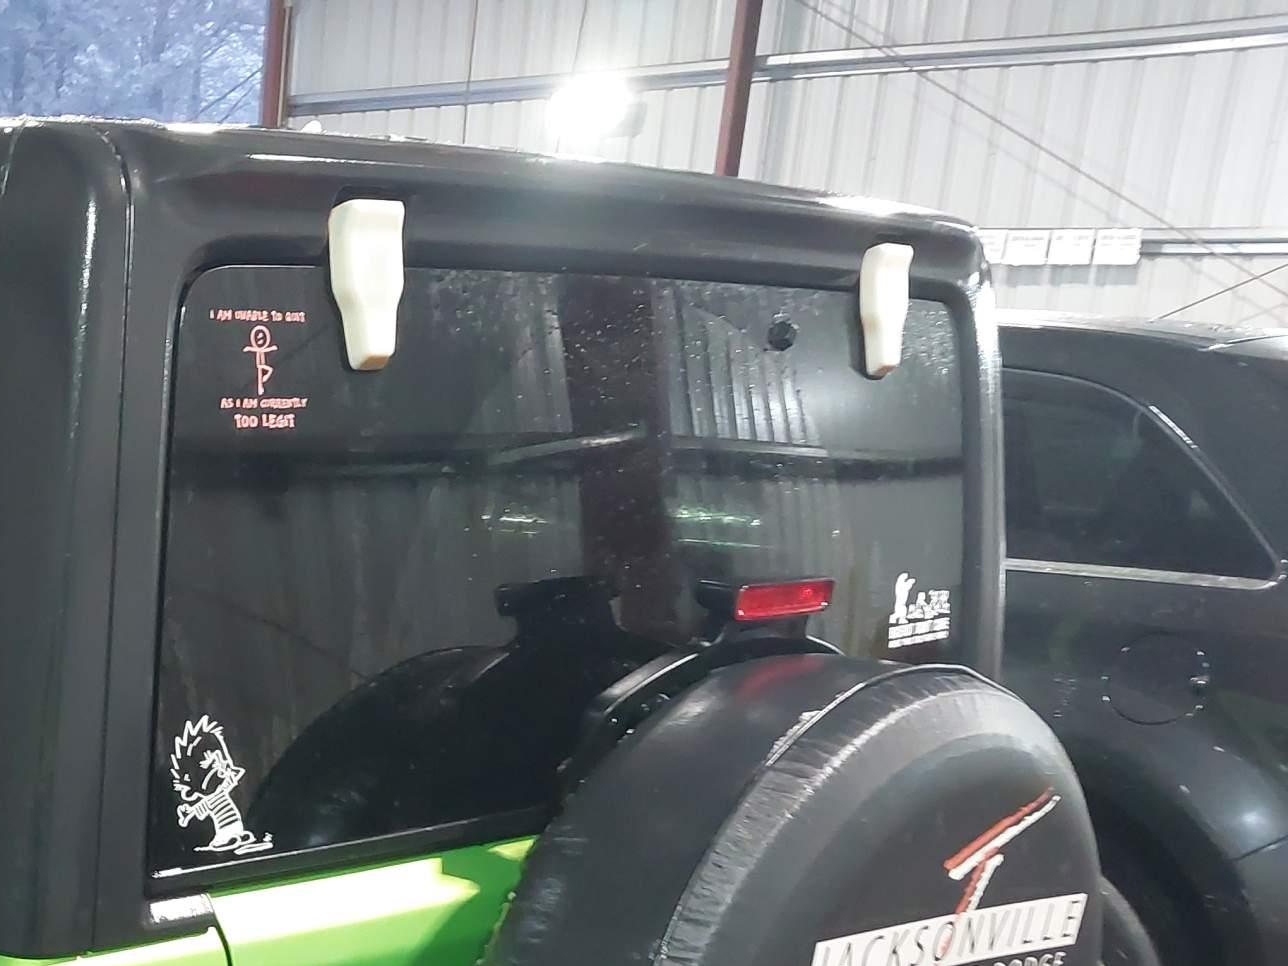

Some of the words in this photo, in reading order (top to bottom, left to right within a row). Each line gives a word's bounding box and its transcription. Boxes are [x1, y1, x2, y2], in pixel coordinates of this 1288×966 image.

[216, 309, 233, 321] AM
[271, 310, 284, 322] TO
[220, 398, 234, 409] AS
[242, 398, 258, 409] AM
[234, 414, 258, 428] TOO
[262, 413, 295, 428] LEGIT
